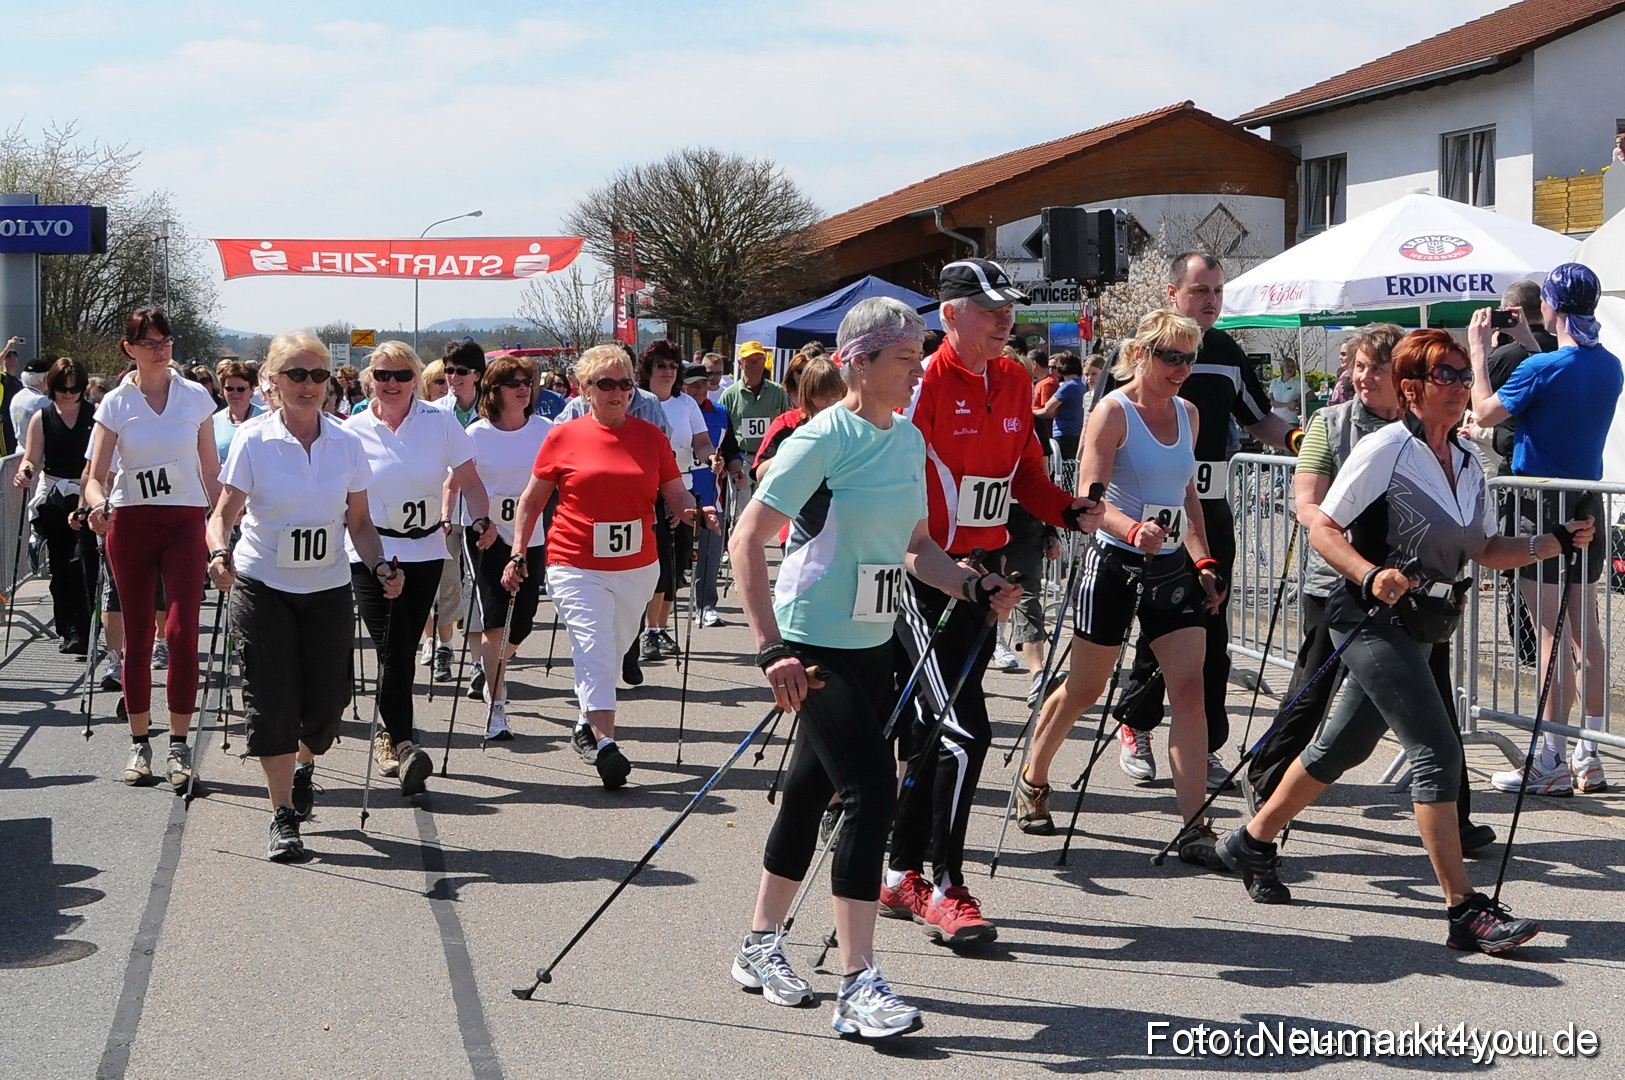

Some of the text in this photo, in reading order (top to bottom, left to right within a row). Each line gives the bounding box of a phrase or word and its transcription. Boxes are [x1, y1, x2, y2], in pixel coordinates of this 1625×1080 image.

[1385, 273, 1497, 298] ERDINGER
[749, 420, 765, 435] 50
[136, 467, 171, 499] 114
[402, 500, 426, 529] 21
[973, 480, 1009, 521] 107
[291, 528, 327, 561] 110
[609, 523, 631, 553] 51
[874, 567, 902, 613] 113
